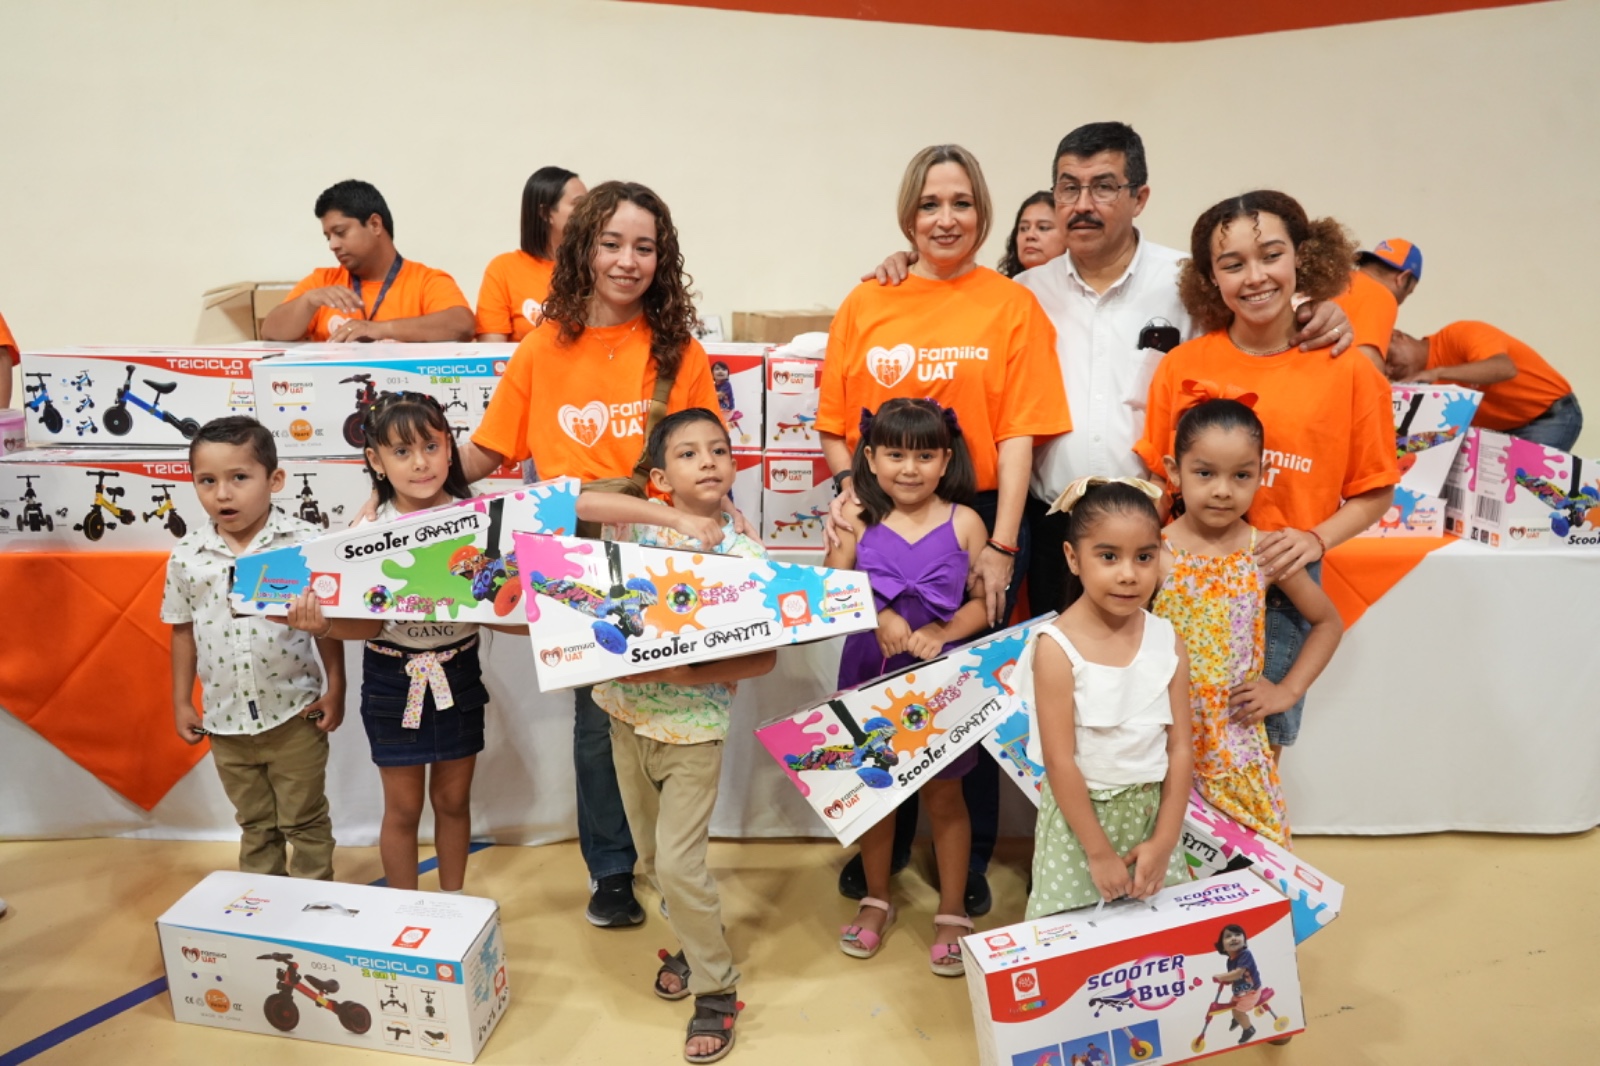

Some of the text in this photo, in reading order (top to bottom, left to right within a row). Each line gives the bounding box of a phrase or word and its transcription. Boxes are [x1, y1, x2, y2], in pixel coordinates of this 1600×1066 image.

[918, 346, 989, 361] Familia
[166, 358, 244, 370] TRICICLO
[416, 364, 487, 375] TRICICLO
[917, 362, 958, 382] UAT
[1261, 448, 1313, 474] milia
[415, 514, 480, 542] GRAFITTI
[407, 625, 454, 638] GANG
[704, 621, 772, 648] GRAFITTI
[564, 651, 584, 663] UAT
[949, 697, 1002, 744] GRAFITTI
[844, 794, 861, 809] UAT
[1173, 882, 1242, 903] SCOOTER
[1213, 890, 1250, 903] Bug
[201, 956, 217, 965] UAT
[311, 961, 337, 972] 003-1
[345, 955, 429, 975] TRICICLO
[372, 970, 389, 979] en
[1087, 954, 1185, 991] SCOOTER
[1137, 980, 1186, 1002] Bug
